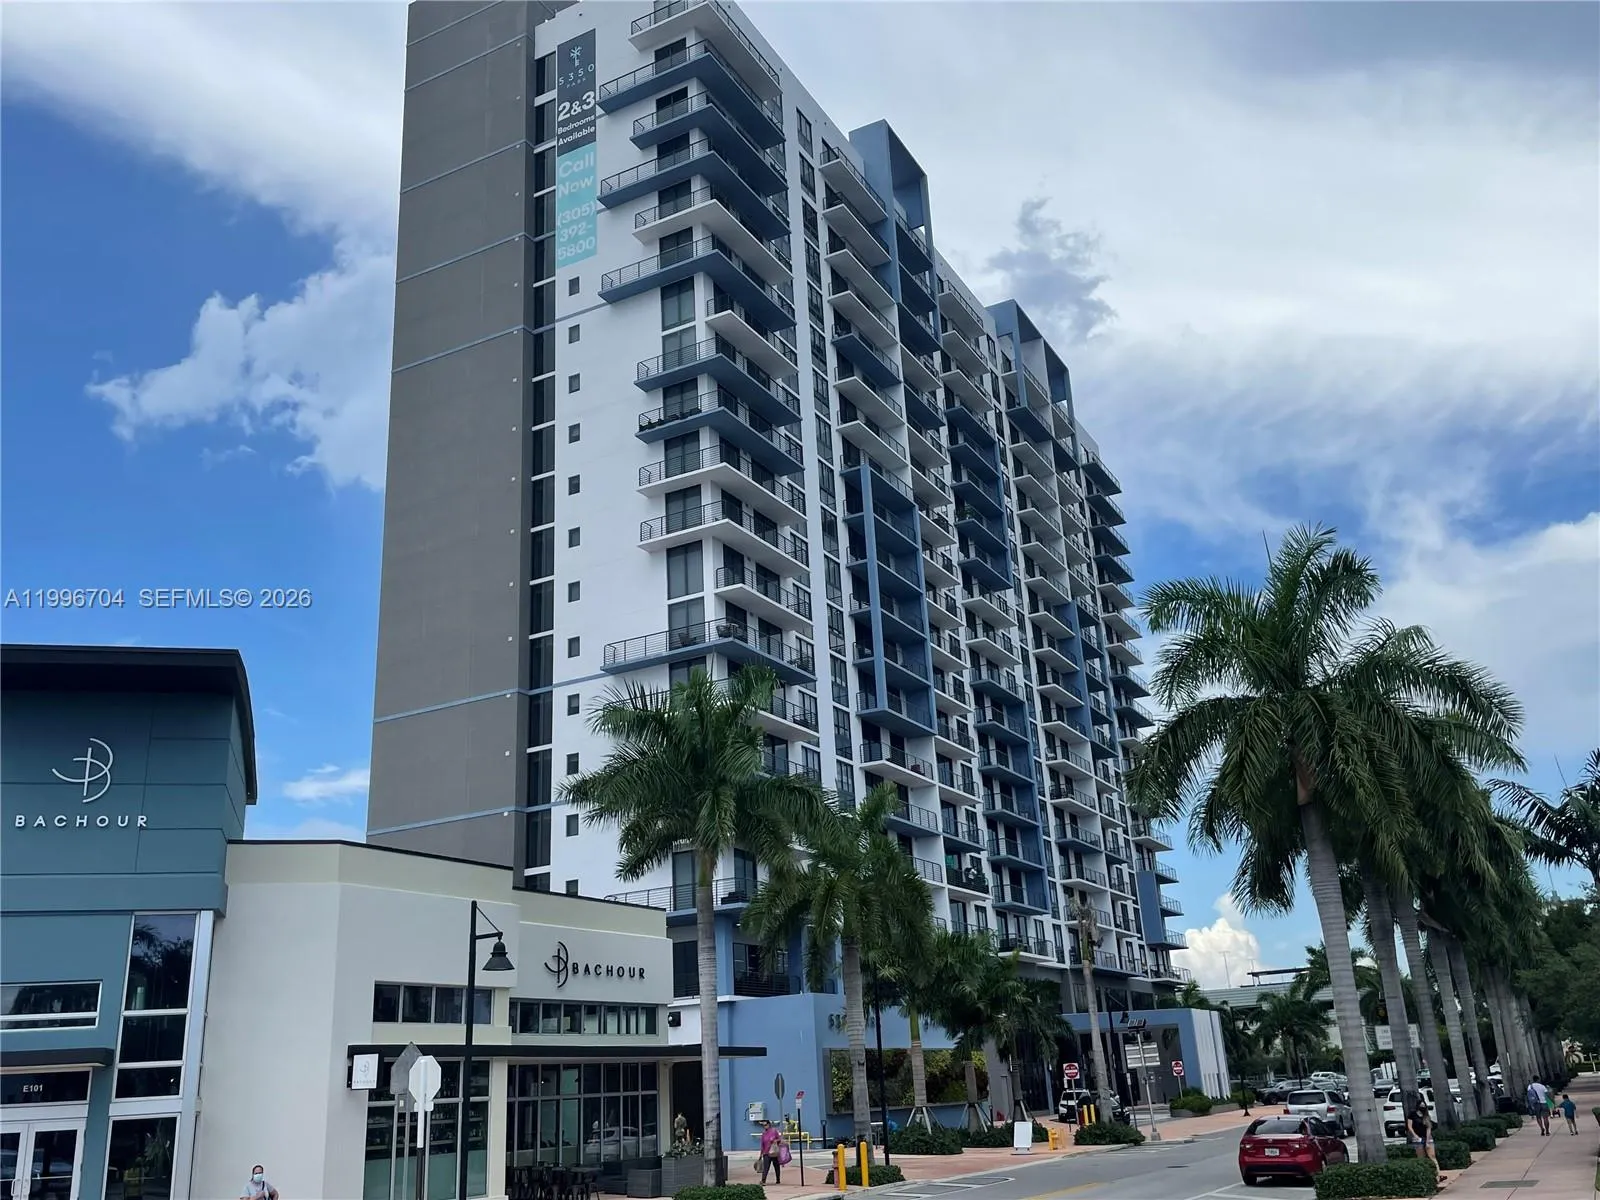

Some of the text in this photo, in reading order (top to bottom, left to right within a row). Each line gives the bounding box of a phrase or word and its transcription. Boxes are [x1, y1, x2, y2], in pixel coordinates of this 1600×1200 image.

[559, 63, 595, 86] 5350
[557, 90, 595, 122] 2&3
[557, 114, 595, 135] Bedrooms
[558, 126, 596, 146] Available
[559, 152, 594, 178] Call
[558, 175, 594, 198] Now
[557, 200, 595, 229] (305)
[560, 221, 593, 242] 392-
[558, 236, 595, 260] 5800
[14, 814, 148, 828] BACHOUR
[571, 962, 646, 980] BACHOUR
[22, 1084, 44, 1093] E101
